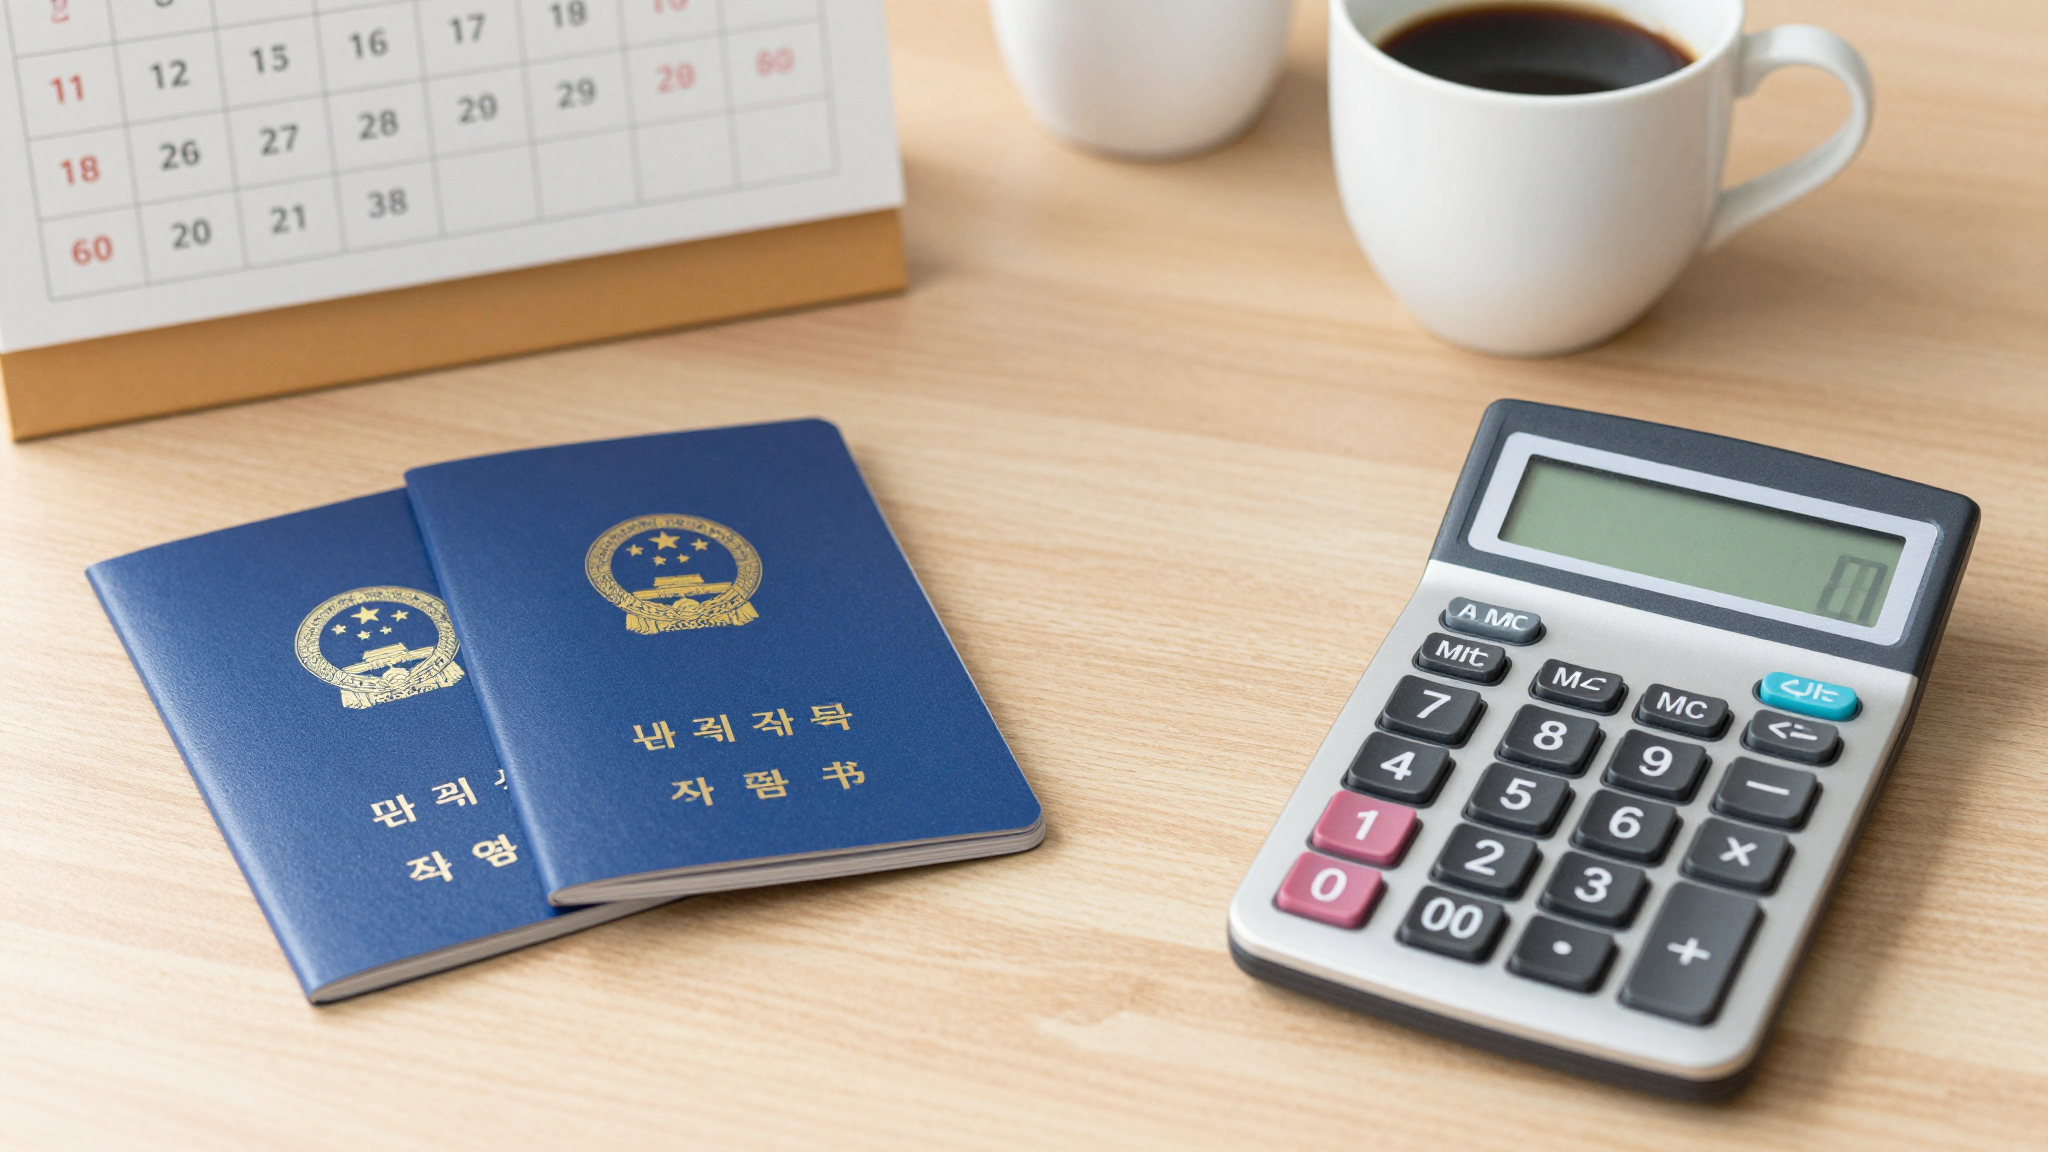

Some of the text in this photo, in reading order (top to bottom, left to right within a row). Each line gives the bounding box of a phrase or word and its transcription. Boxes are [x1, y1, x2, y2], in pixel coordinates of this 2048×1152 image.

[51, 74, 84, 104] 11
[150, 60, 189, 90] 12
[251, 44, 290, 74] 15
[350, 29, 389, 60] 16
[449, 13, 486, 44] 17
[60, 155, 101, 186] 18
[160, 140, 201, 171] 26
[260, 124, 299, 157] 27
[359, 109, 400, 141] 28
[71, 188, 409, 267] 60 20 21 38
[1416, 689, 1452, 719] 7
[1656, 691, 1708, 720] MC
[1532, 720, 1568, 751] 8
[1380, 751, 1416, 781] 4
[1638, 745, 1674, 778] 9
[1499, 777, 1537, 811] 5
[1355, 809, 1380, 842] 1
[1608, 805, 1645, 839] 6
[1464, 839, 1505, 877] 2
[1310, 867, 1348, 903] 0
[1573, 866, 1613, 903] 3
[1420, 896, 1484, 940] 00
